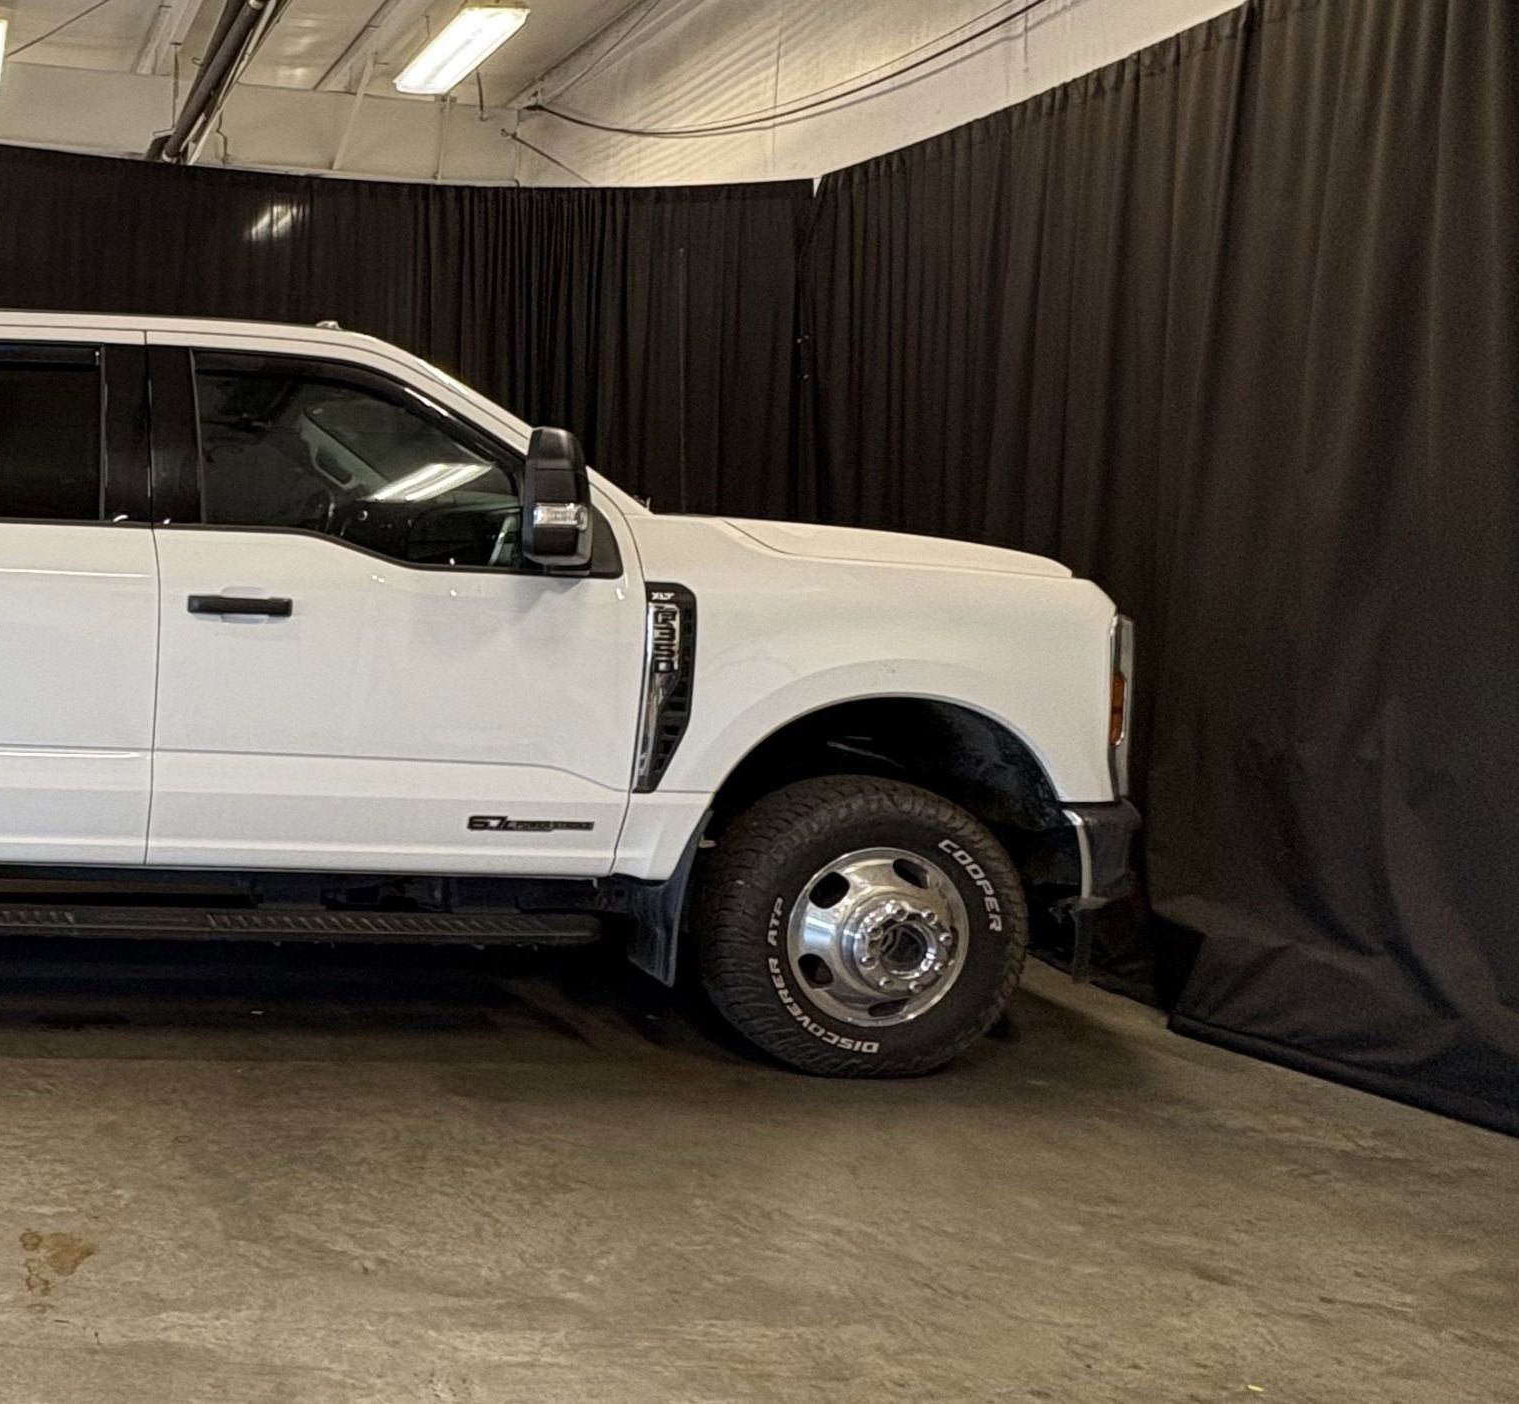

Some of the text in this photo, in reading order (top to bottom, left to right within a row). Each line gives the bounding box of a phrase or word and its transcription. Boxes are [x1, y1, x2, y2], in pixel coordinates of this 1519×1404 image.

[651, 592, 675, 601] XLT
[938, 838, 1003, 933] COOPER
[767, 897, 880, 1055] DISCOVERER ATP
